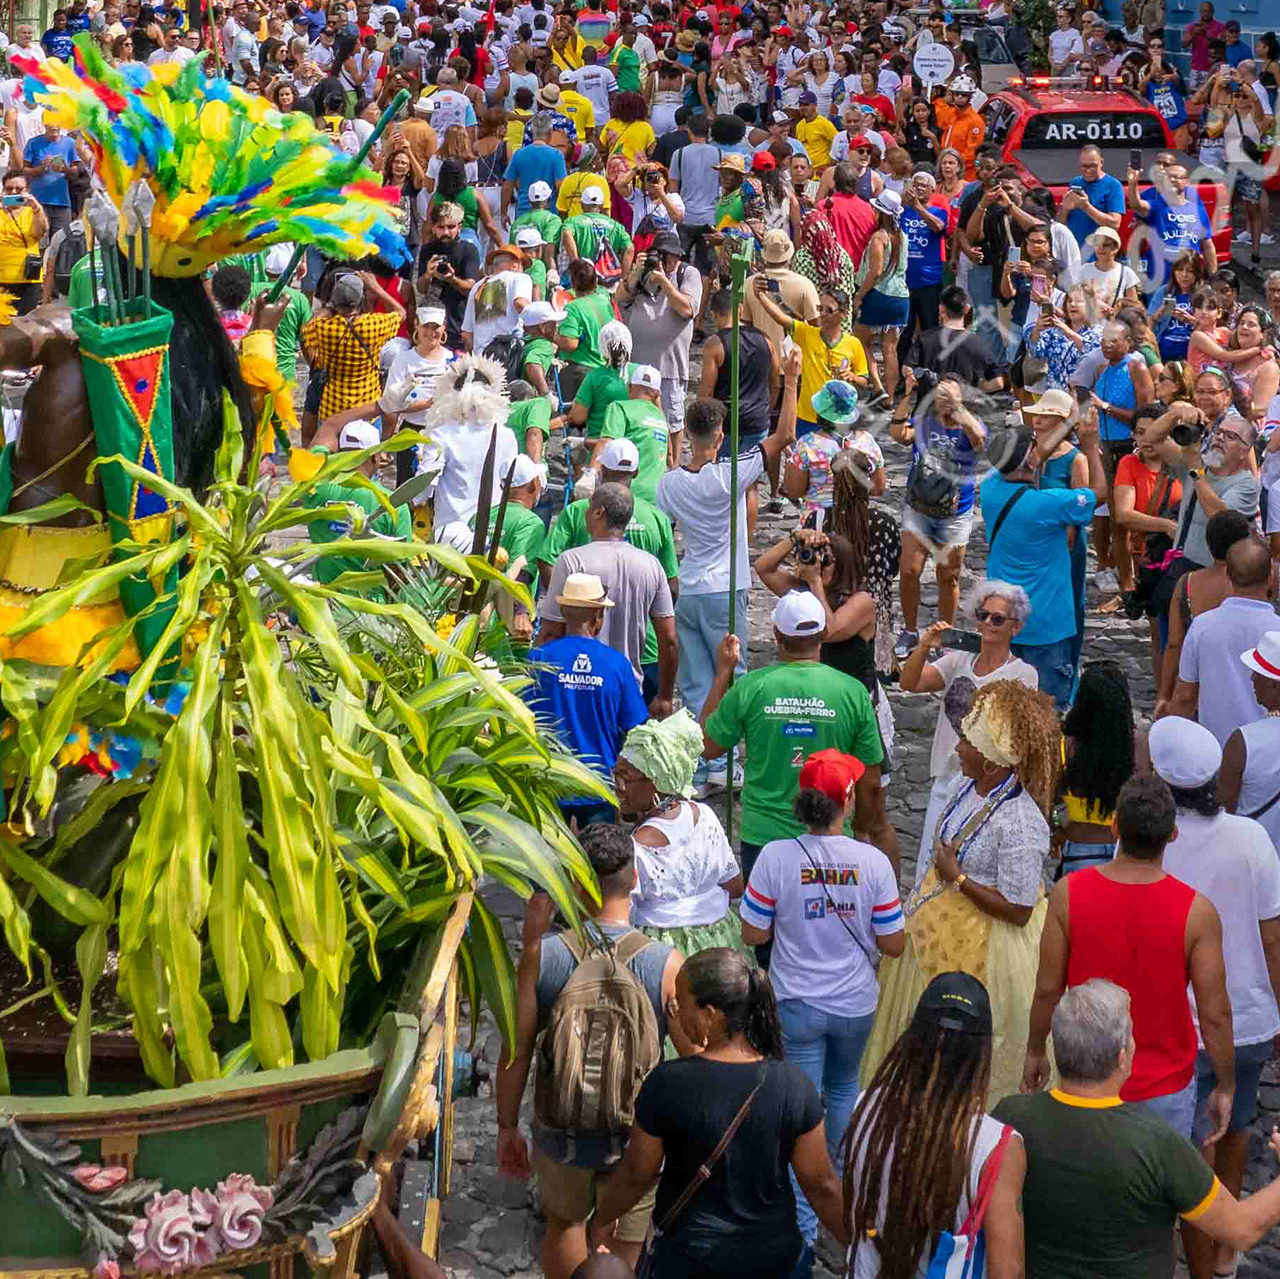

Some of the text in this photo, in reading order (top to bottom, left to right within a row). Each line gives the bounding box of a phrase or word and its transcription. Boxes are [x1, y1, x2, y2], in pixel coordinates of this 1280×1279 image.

[1045, 122, 1143, 140] AR-0110
[1167, 213, 1196, 223] DOIS
[1163, 229, 1198, 244] JULHO
[558, 673, 603, 687] SALVADOR
[775, 697, 825, 709] BATALHÃO
[764, 706, 836, 718] QUEBRA-FERRO
